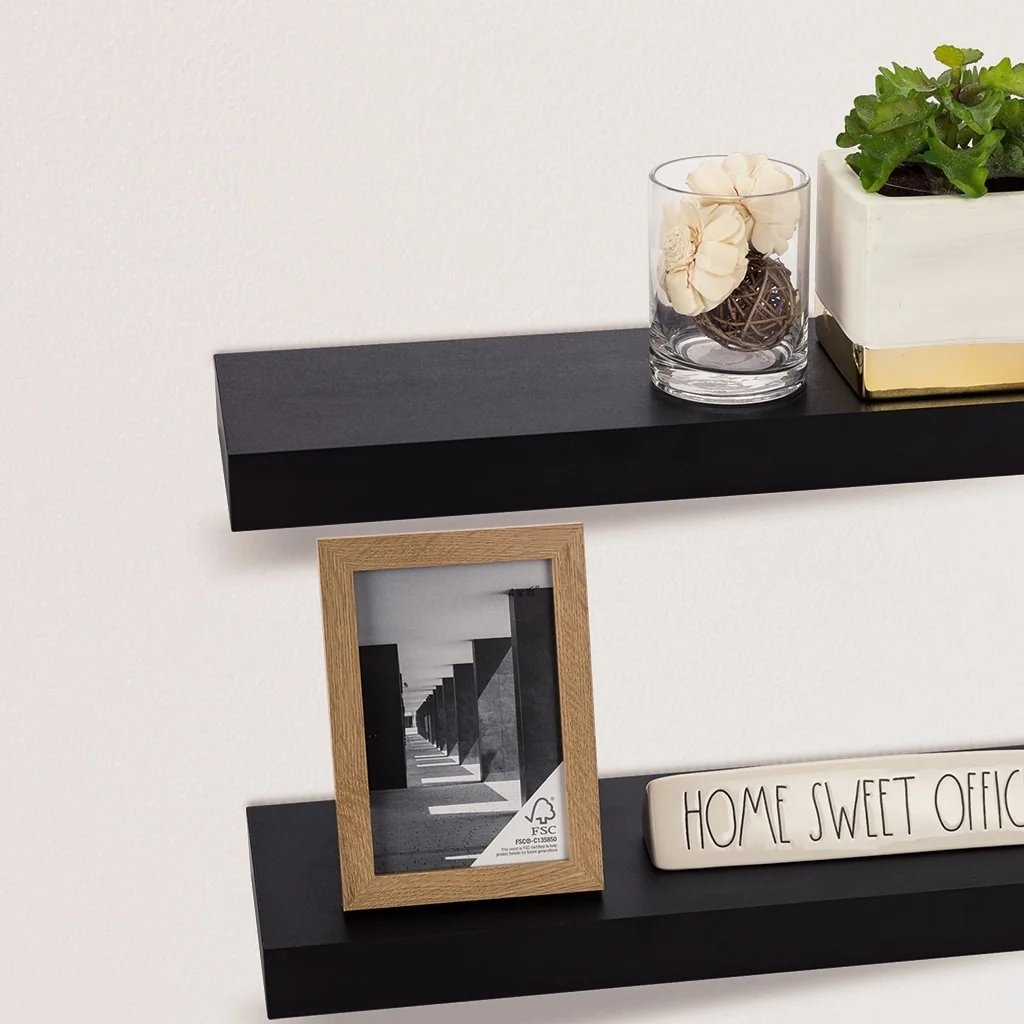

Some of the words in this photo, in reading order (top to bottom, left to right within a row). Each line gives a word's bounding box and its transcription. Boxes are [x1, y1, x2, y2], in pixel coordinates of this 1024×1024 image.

[531, 825, 557, 836] FSC
[684, 784, 791, 850] HOME
[810, 776, 916, 842] SWEET
